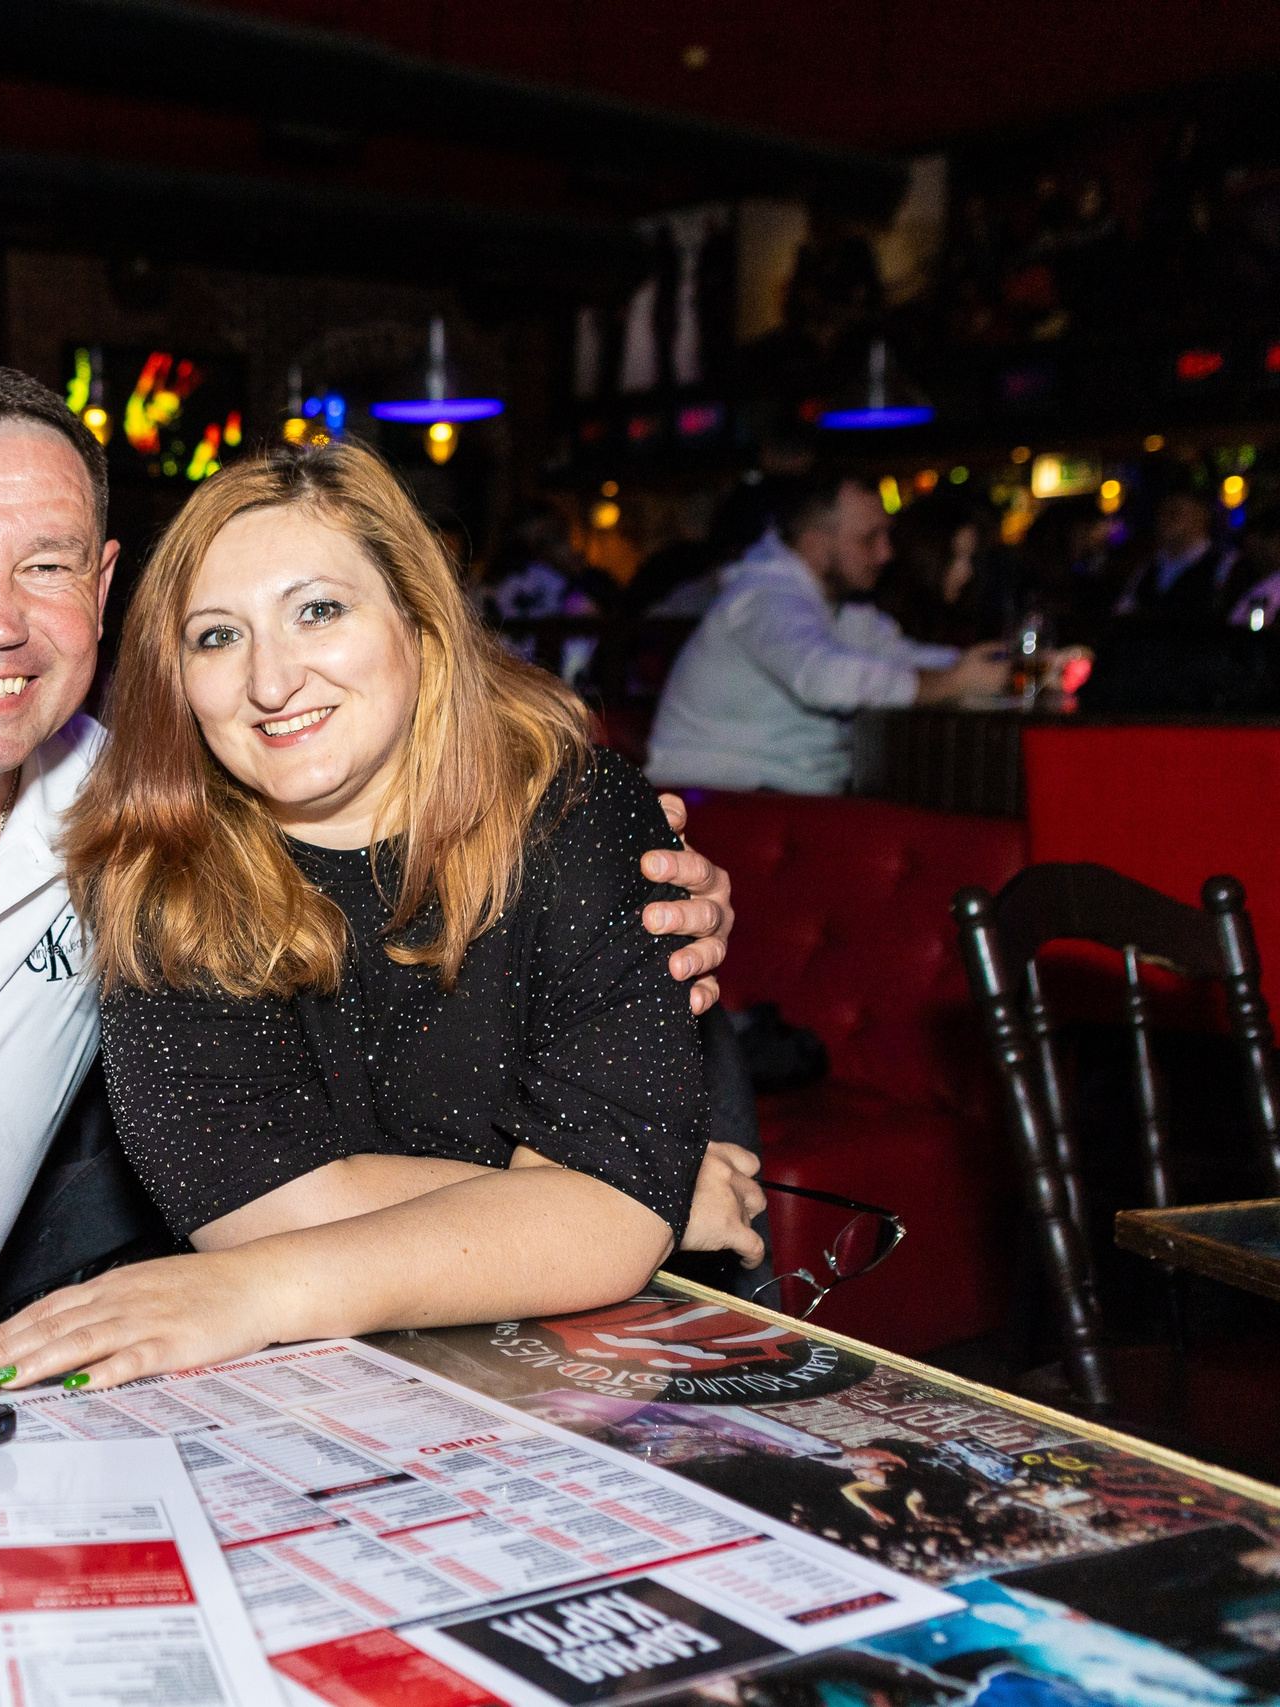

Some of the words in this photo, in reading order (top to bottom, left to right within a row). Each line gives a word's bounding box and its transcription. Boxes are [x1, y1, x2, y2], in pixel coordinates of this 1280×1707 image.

[310, 1345, 350, 1358] МЕНЮ
[169, 1366, 211, 1381] ВИДЕ?
[213, 1353, 300, 1374] ЭЛЕКТРОННОМ
[490, 1337, 674, 1393] STONES
[574, 1381, 636, 1399] The
[678, 1372, 800, 1396] ROLLING
[418, 1434, 502, 1455] ПИВО
[488, 1590, 671, 1654] КАРТА
[545, 1618, 721, 1684] БАРНАЯ
